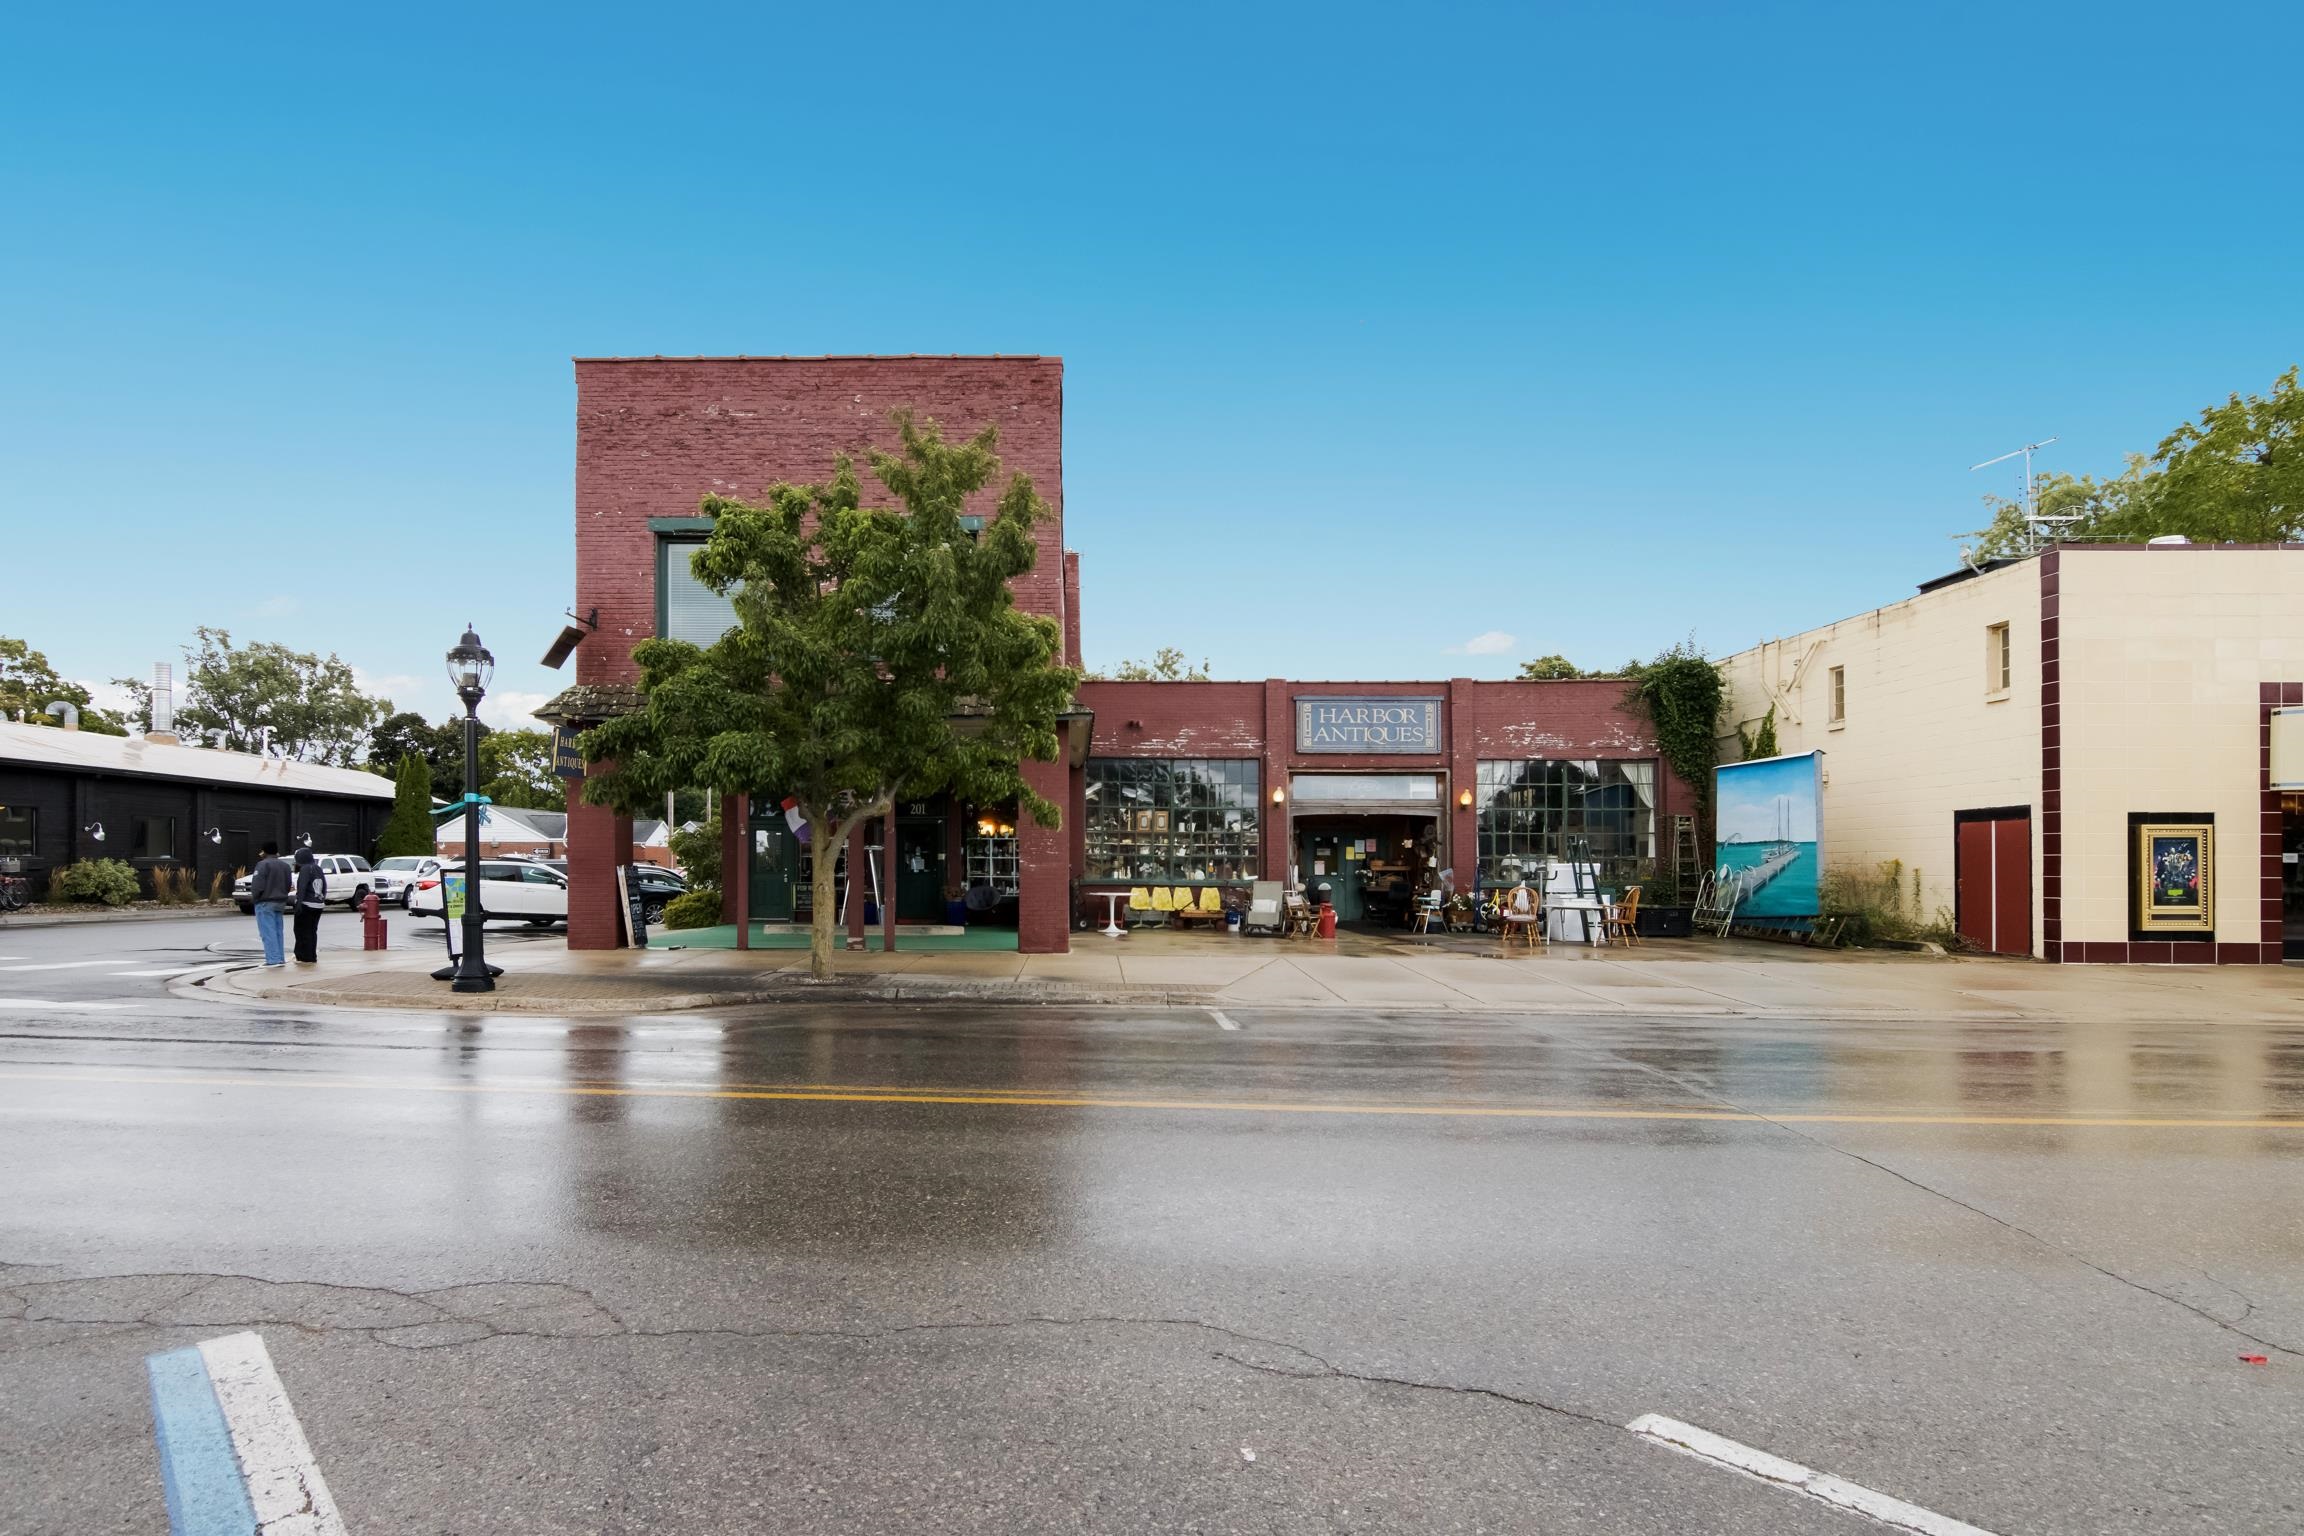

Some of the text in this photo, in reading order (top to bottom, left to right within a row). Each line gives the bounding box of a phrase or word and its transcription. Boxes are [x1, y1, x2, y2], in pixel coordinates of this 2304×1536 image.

[1319, 708, 1419, 724] HARBOR
[1313, 726, 1424, 745] ANTIQUES
[556, 755, 585, 770] ANTIQUES
[910, 803, 926, 815] 201
